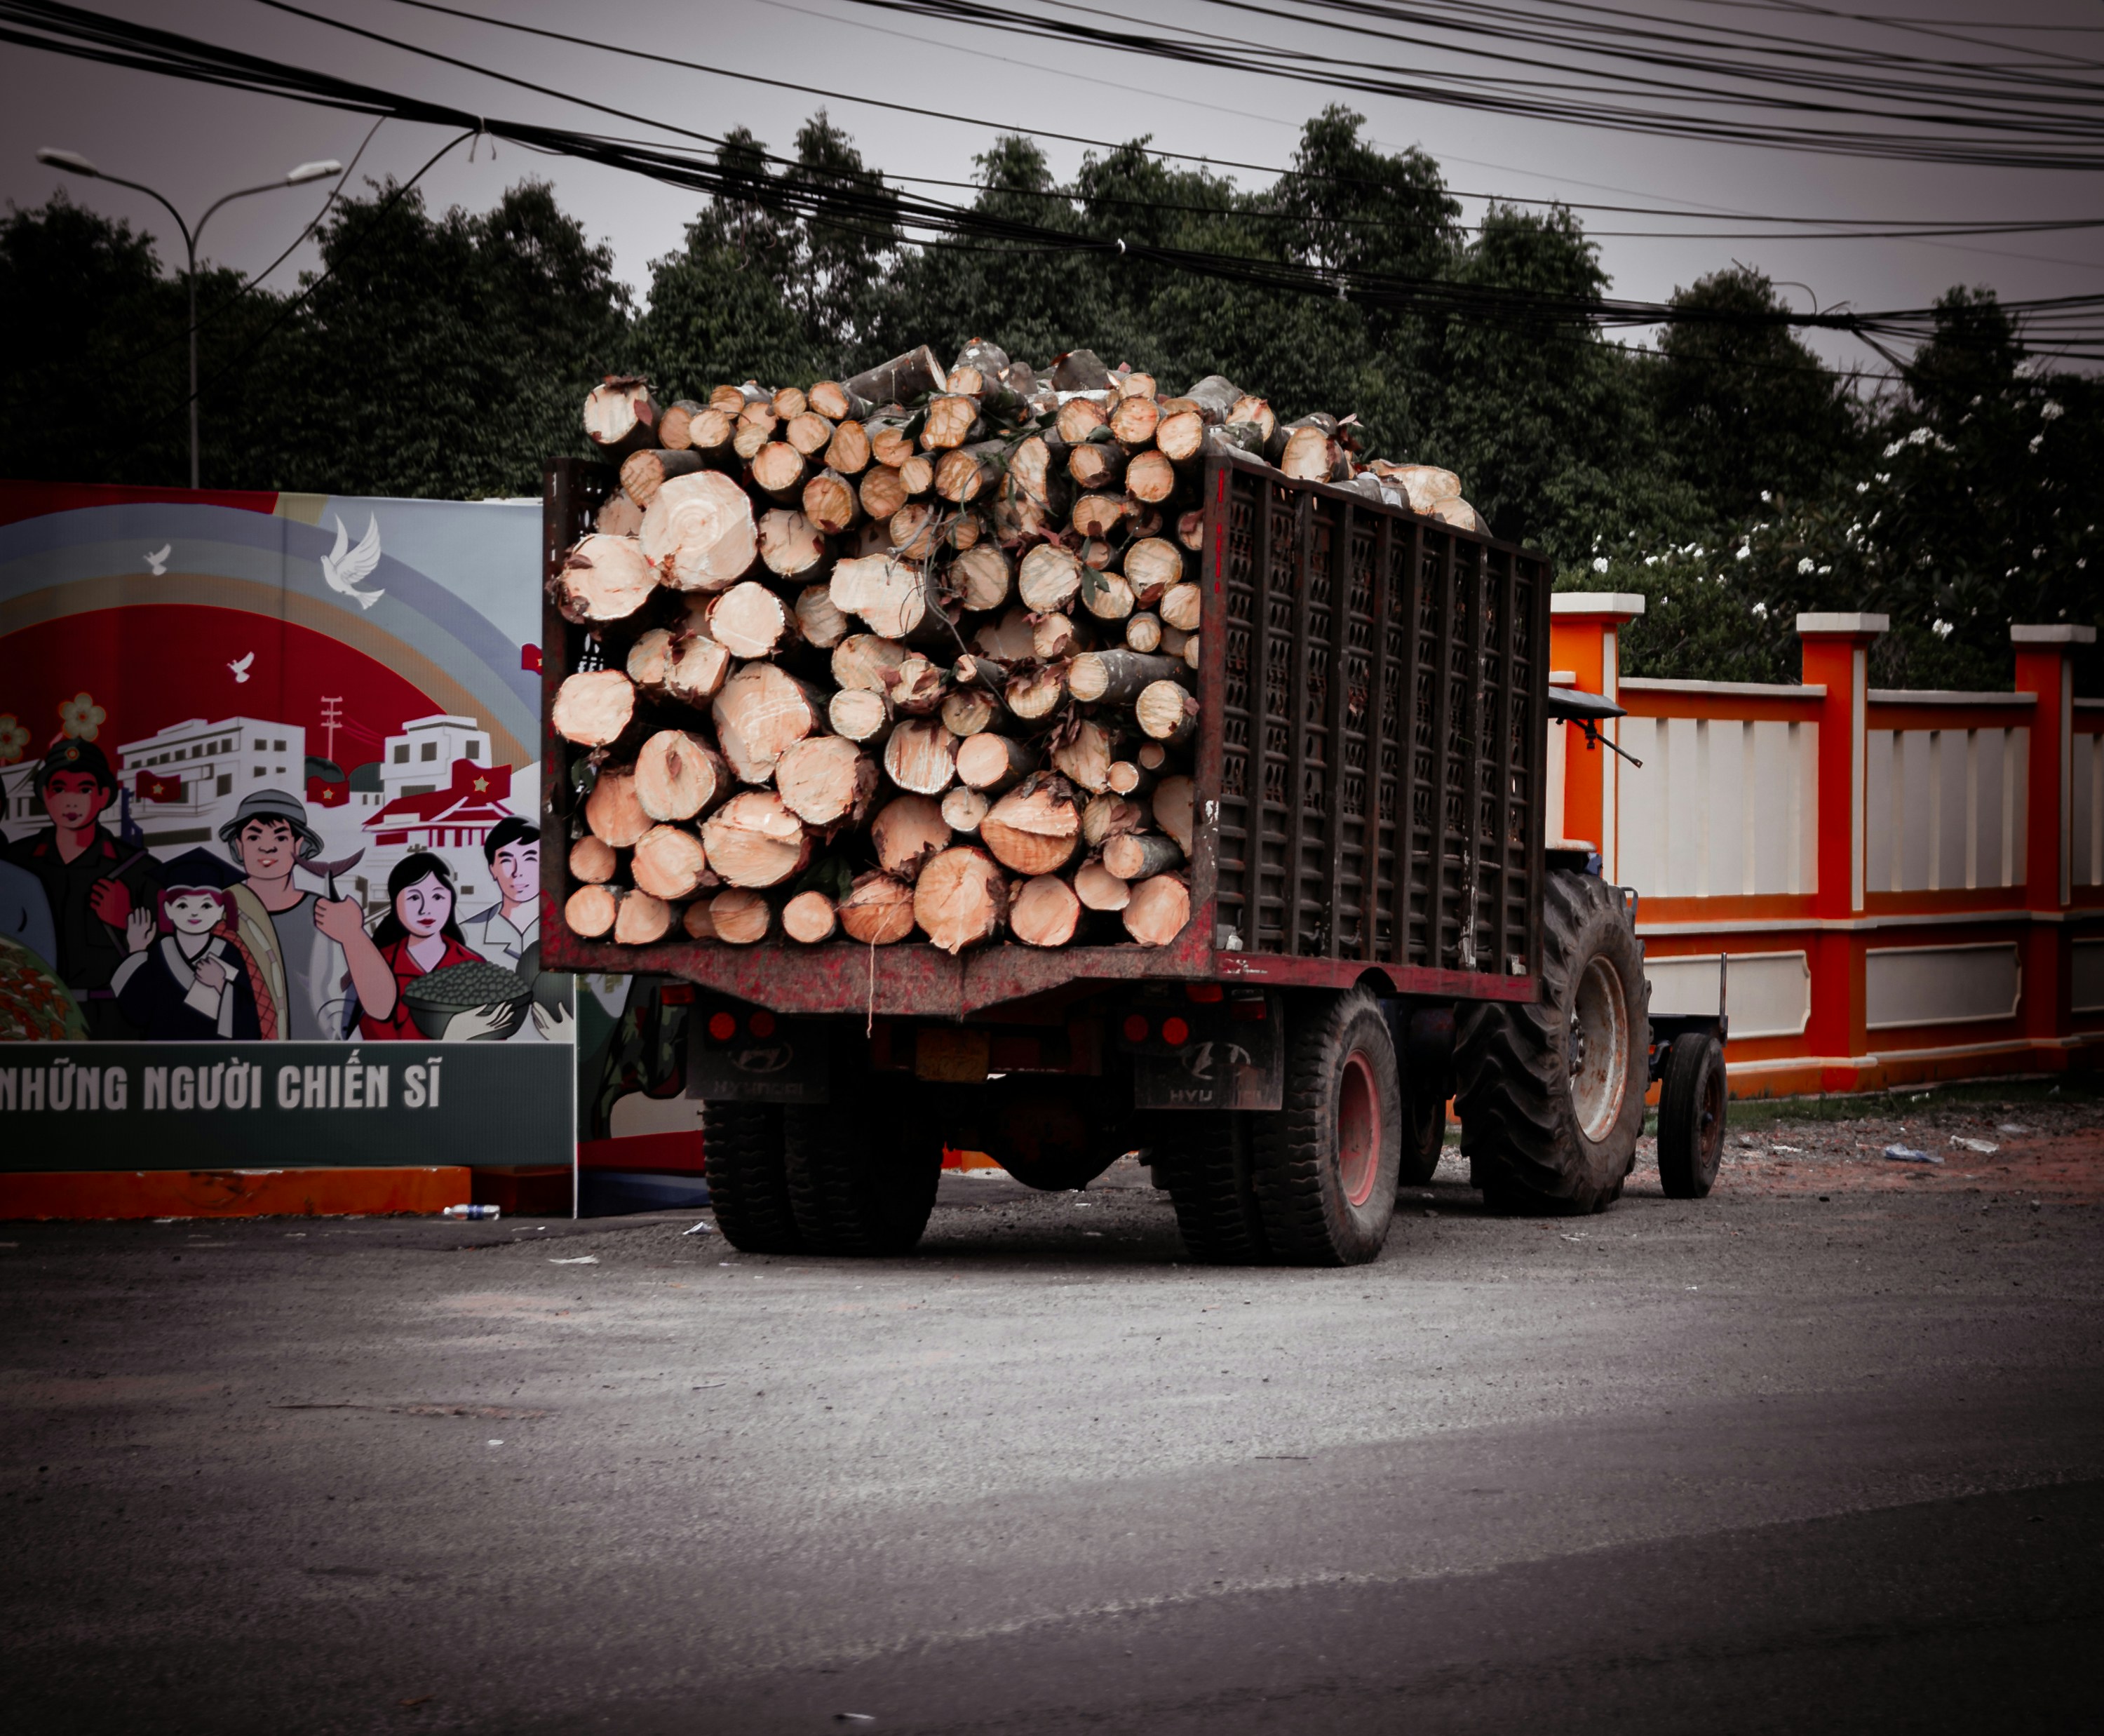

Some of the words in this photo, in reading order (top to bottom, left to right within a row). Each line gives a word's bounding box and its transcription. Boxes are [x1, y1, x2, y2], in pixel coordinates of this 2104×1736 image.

[0, 1057, 128, 1111] NHỮNG
[143, 1056, 262, 1110] NGƯỜI
[278, 1049, 389, 1109] CHIẾN
[403, 1056, 443, 1108] SĨ
